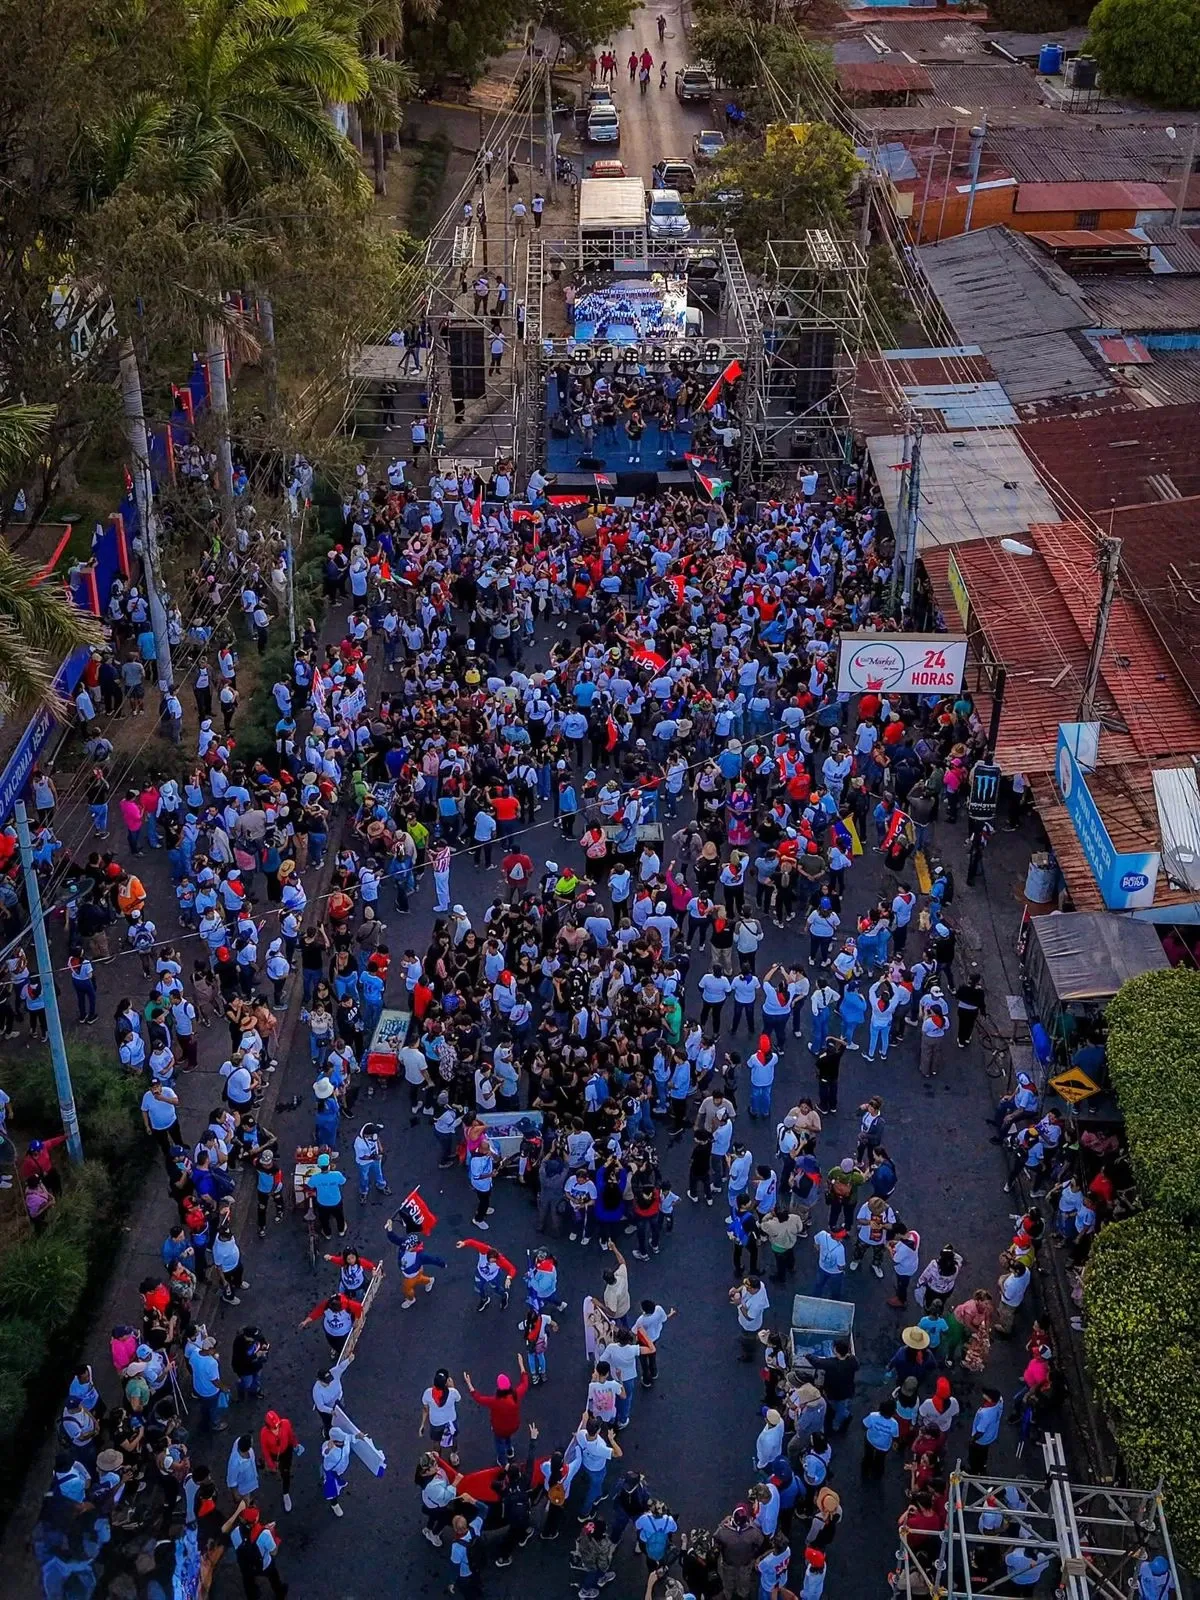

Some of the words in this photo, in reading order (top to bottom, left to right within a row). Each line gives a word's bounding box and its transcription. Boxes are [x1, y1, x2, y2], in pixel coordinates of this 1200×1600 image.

[868, 655, 897, 666] Market
[923, 649, 946, 669] 24
[911, 672, 955, 686] HORAS
[3, 747, 34, 807] NACIONAL
[1074, 806, 1082, 830] 24
[1081, 824, 1104, 881] HORAS
[1090, 818, 1112, 872] SUPER
[1122, 879, 1146, 888] PURA
